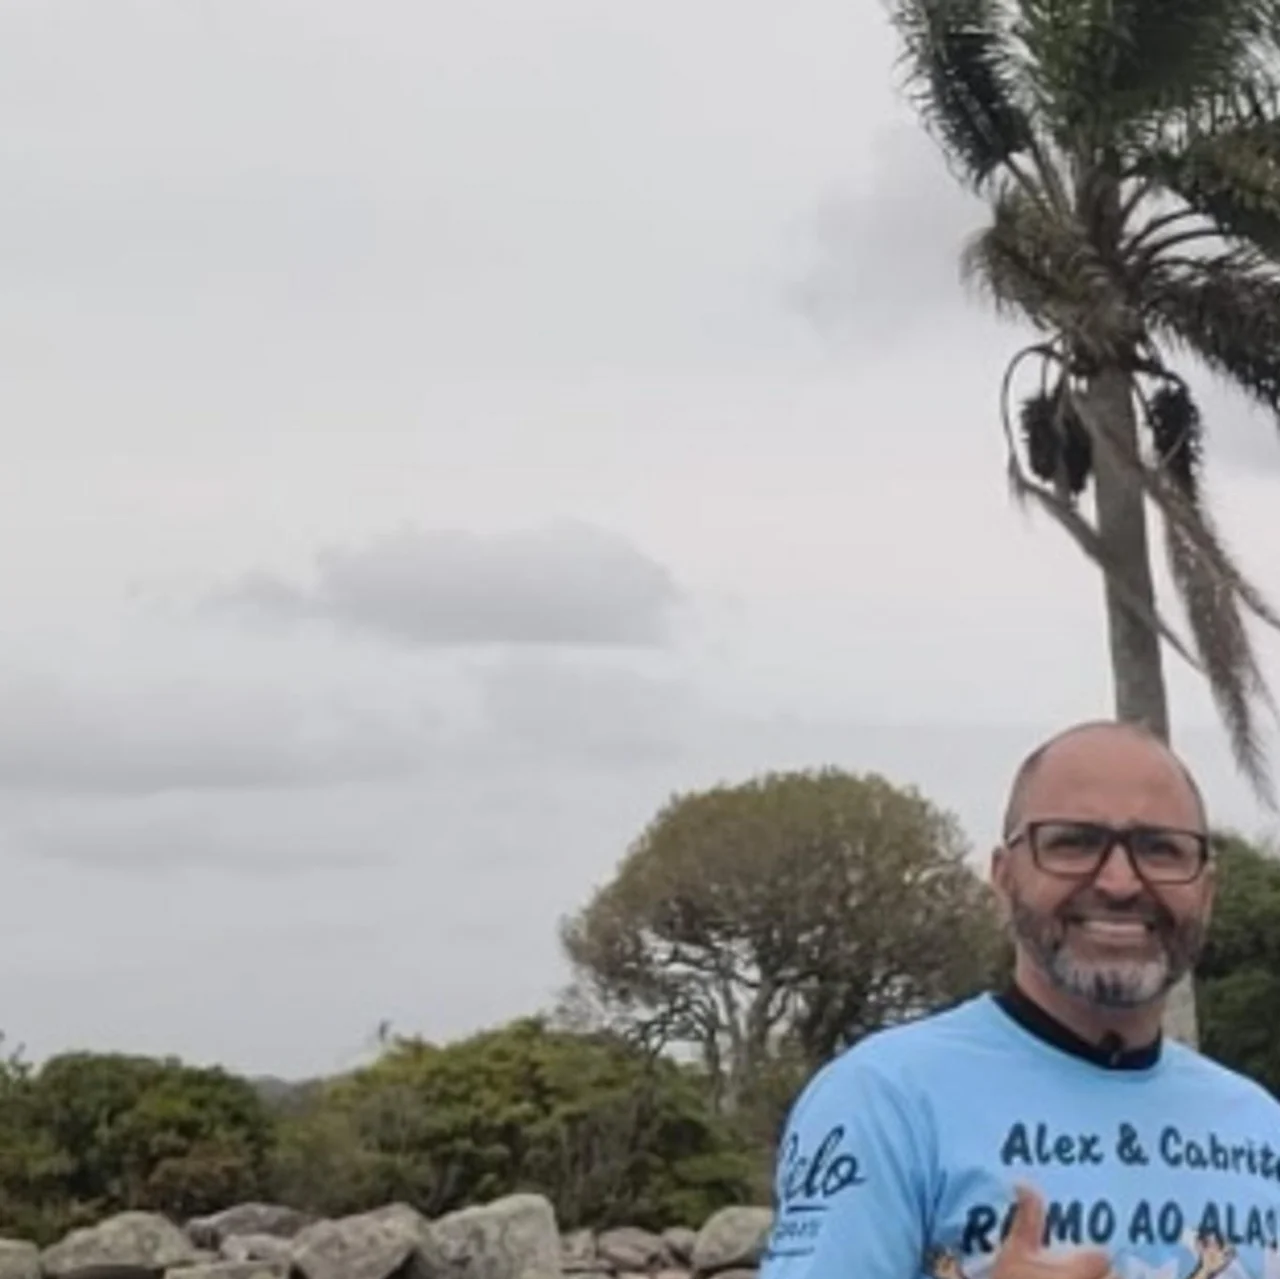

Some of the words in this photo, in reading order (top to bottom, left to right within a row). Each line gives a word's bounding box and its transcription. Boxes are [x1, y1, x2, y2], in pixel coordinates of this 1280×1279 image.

[1001, 1121, 1103, 1166] Alex
[1116, 1122, 1149, 1166] &
[1128, 1201, 1184, 1245] AO
